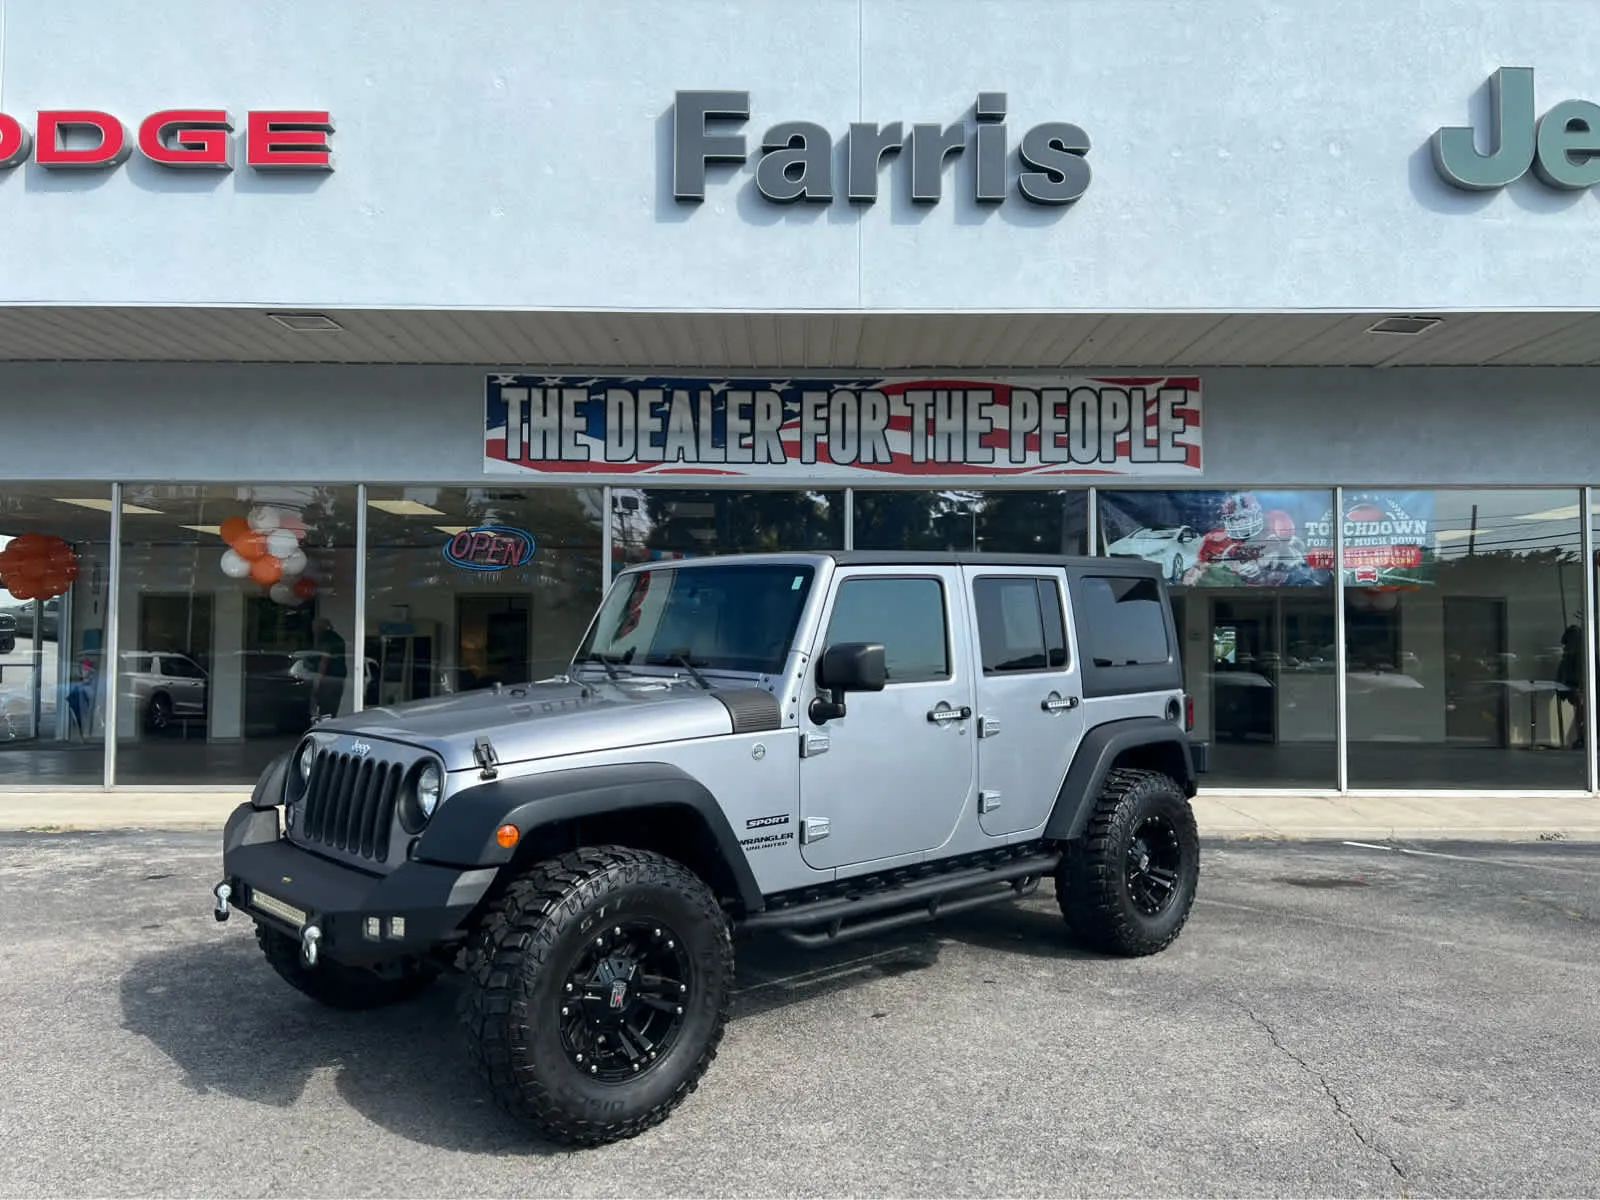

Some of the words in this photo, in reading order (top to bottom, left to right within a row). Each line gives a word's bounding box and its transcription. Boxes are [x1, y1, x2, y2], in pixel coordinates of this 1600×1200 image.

[0, 109, 335, 173] DGE
[673, 90, 1093, 206] Farris
[1431, 66, 1600, 191] Je
[501, 386, 590, 462] THE
[604, 387, 788, 464] DEALER
[800, 387, 893, 465] FOR
[904, 386, 995, 464] THE
[1009, 386, 1188, 464] PEOPLE
[451, 530, 526, 567] OPEN
[1304, 520, 1427, 536] TOCHDOWN
[1354, 537, 1387, 547] MUCH
[748, 816, 787, 827] SPORT
